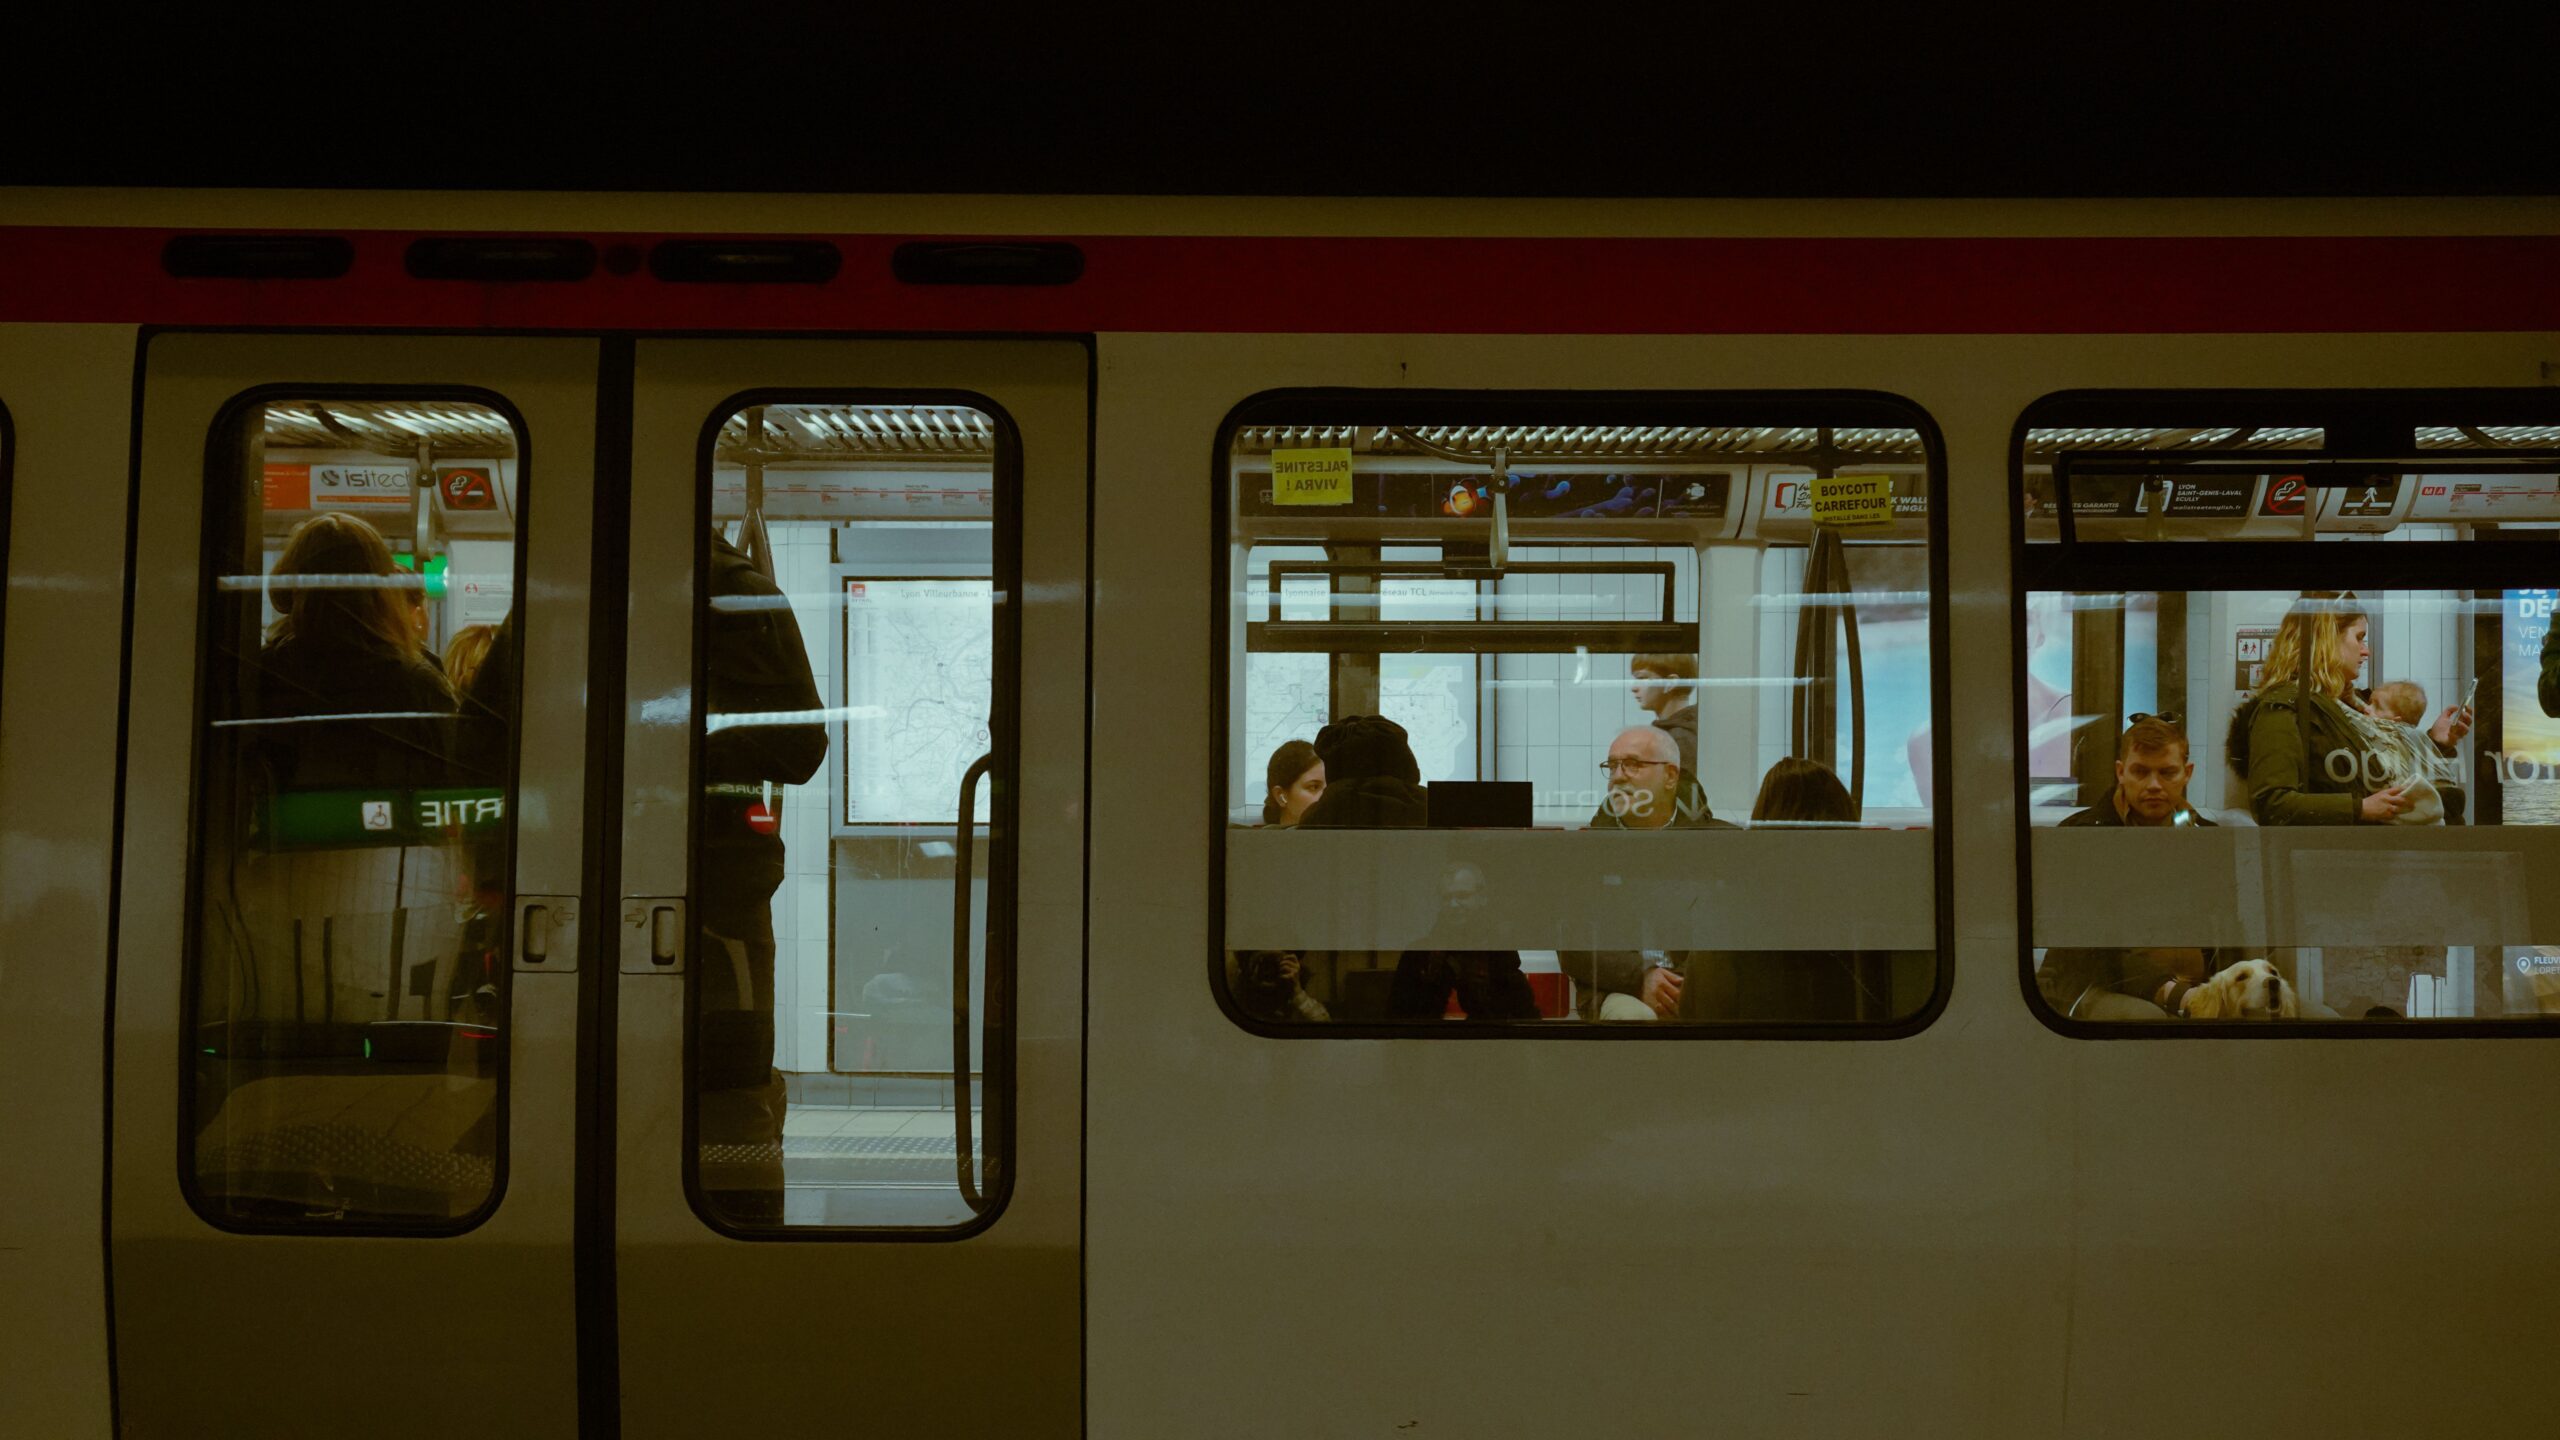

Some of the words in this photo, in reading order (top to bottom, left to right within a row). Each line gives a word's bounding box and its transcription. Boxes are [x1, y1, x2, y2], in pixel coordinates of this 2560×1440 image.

[1820, 482, 1877, 497] BOYCOTT
[1814, 497, 1888, 513] CARREFOUR
[2082, 501, 2120, 509] GARANTIS
[901, 588, 921, 600] Lyon
[923, 588, 979, 599] Villeurbanne
[1380, 587, 1407, 597] éseau
[1410, 587, 1427, 597] TCL
